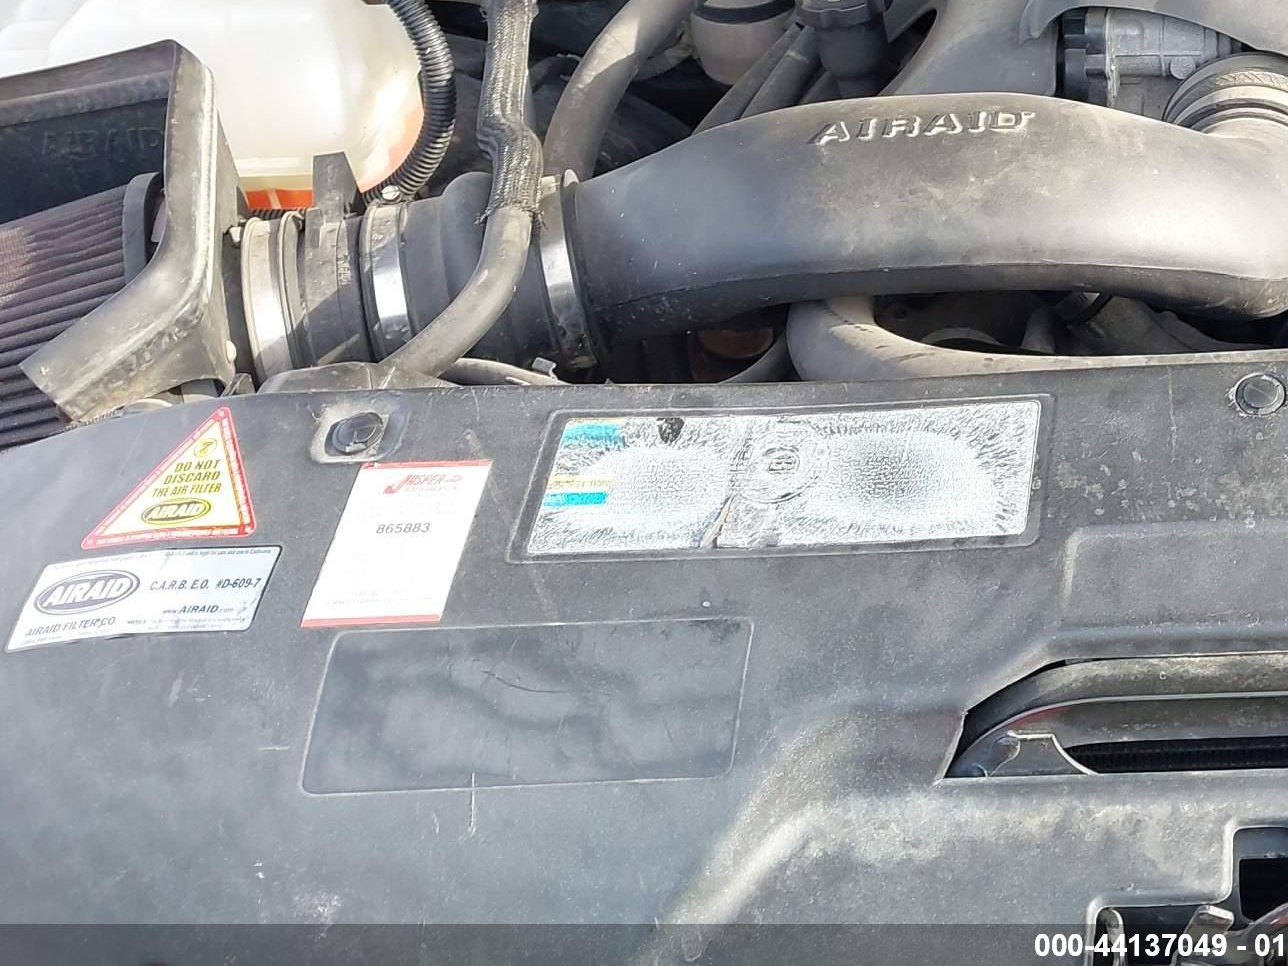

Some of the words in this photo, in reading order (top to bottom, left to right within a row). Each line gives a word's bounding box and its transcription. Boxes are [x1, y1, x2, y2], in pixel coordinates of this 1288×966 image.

[806, 111, 1030, 145] AIRAID
[175, 461, 193, 473] DO
[195, 459, 221, 470] NOT
[164, 471, 221, 485] DISCARD
[152, 487, 169, 498] THE
[170, 485, 188, 495] AIR
[189, 482, 222, 494] FILTER
[376, 522, 431, 534] 865883
[41, 577, 132, 608] AIRAID
[24, 624, 61, 637] AIRAID
